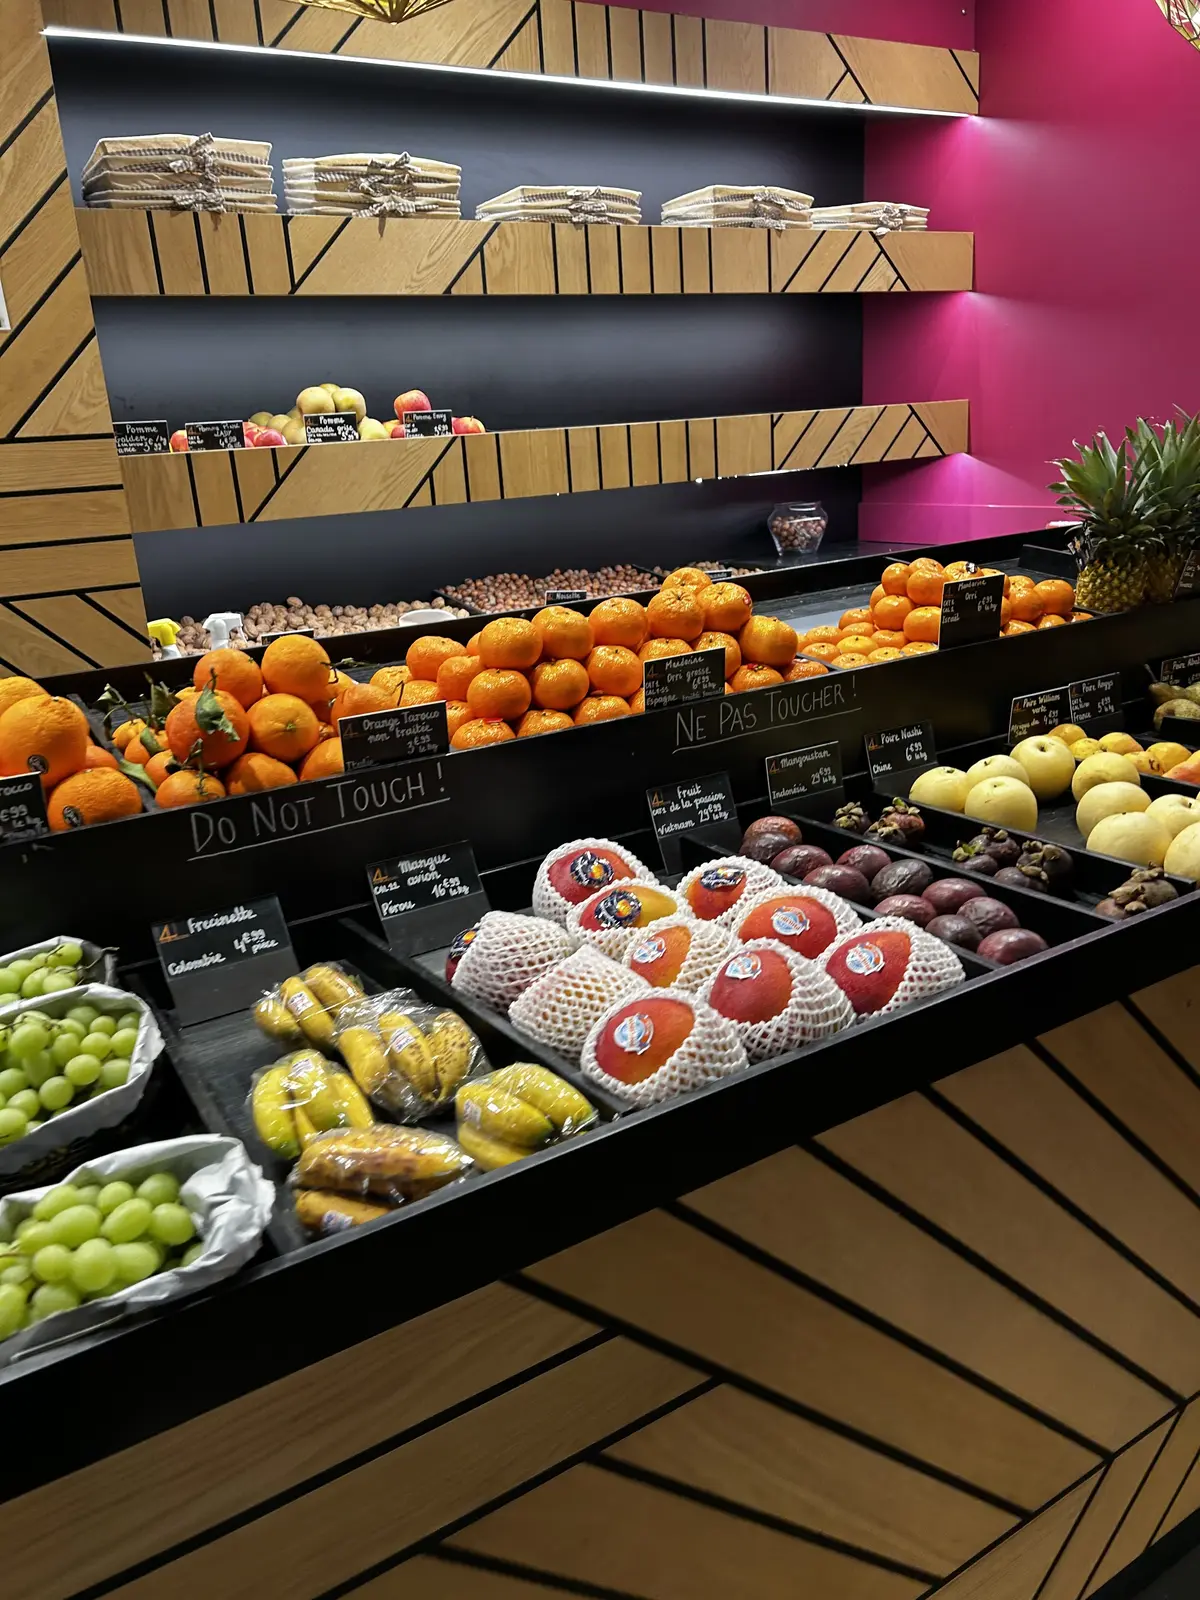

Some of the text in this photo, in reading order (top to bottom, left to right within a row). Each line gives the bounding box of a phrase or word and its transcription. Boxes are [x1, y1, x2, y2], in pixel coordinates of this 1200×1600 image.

[125, 424, 158, 434] Pomme
[306, 425, 335, 433] Canada
[319, 416, 345, 424] Pomme
[667, 666, 712, 683] Orri grosse
[646, 694, 678, 707] Espagne
[363, 711, 440, 732] Orange Tarocco
[676, 708, 707, 746] NE
[719, 701, 758, 735] PAS
[764, 684, 845, 722] TOUCHER
[368, 732, 391, 744] non
[880, 724, 923, 745] Poire Nashi
[780, 750, 831, 769] Mangoustan
[905, 741, 923, 762] 6€99
[872, 761, 893, 774] Chine
[676, 782, 702, 800] Fruit
[669, 791, 726, 813] de la passion
[190, 811, 237, 853] DO
[252, 796, 316, 837] NOT
[325, 772, 425, 819] TOUCH
[698, 802, 722, 823] 29€99
[657, 819, 696, 836] Vietnam
[397, 853, 451, 875] Mangue
[407, 870, 442, 887] avion
[431, 876, 461, 899] 16€99
[380, 899, 416, 917] Pérou
[233, 928, 266, 954] 4€99
[167, 951, 226, 976] Colombie
